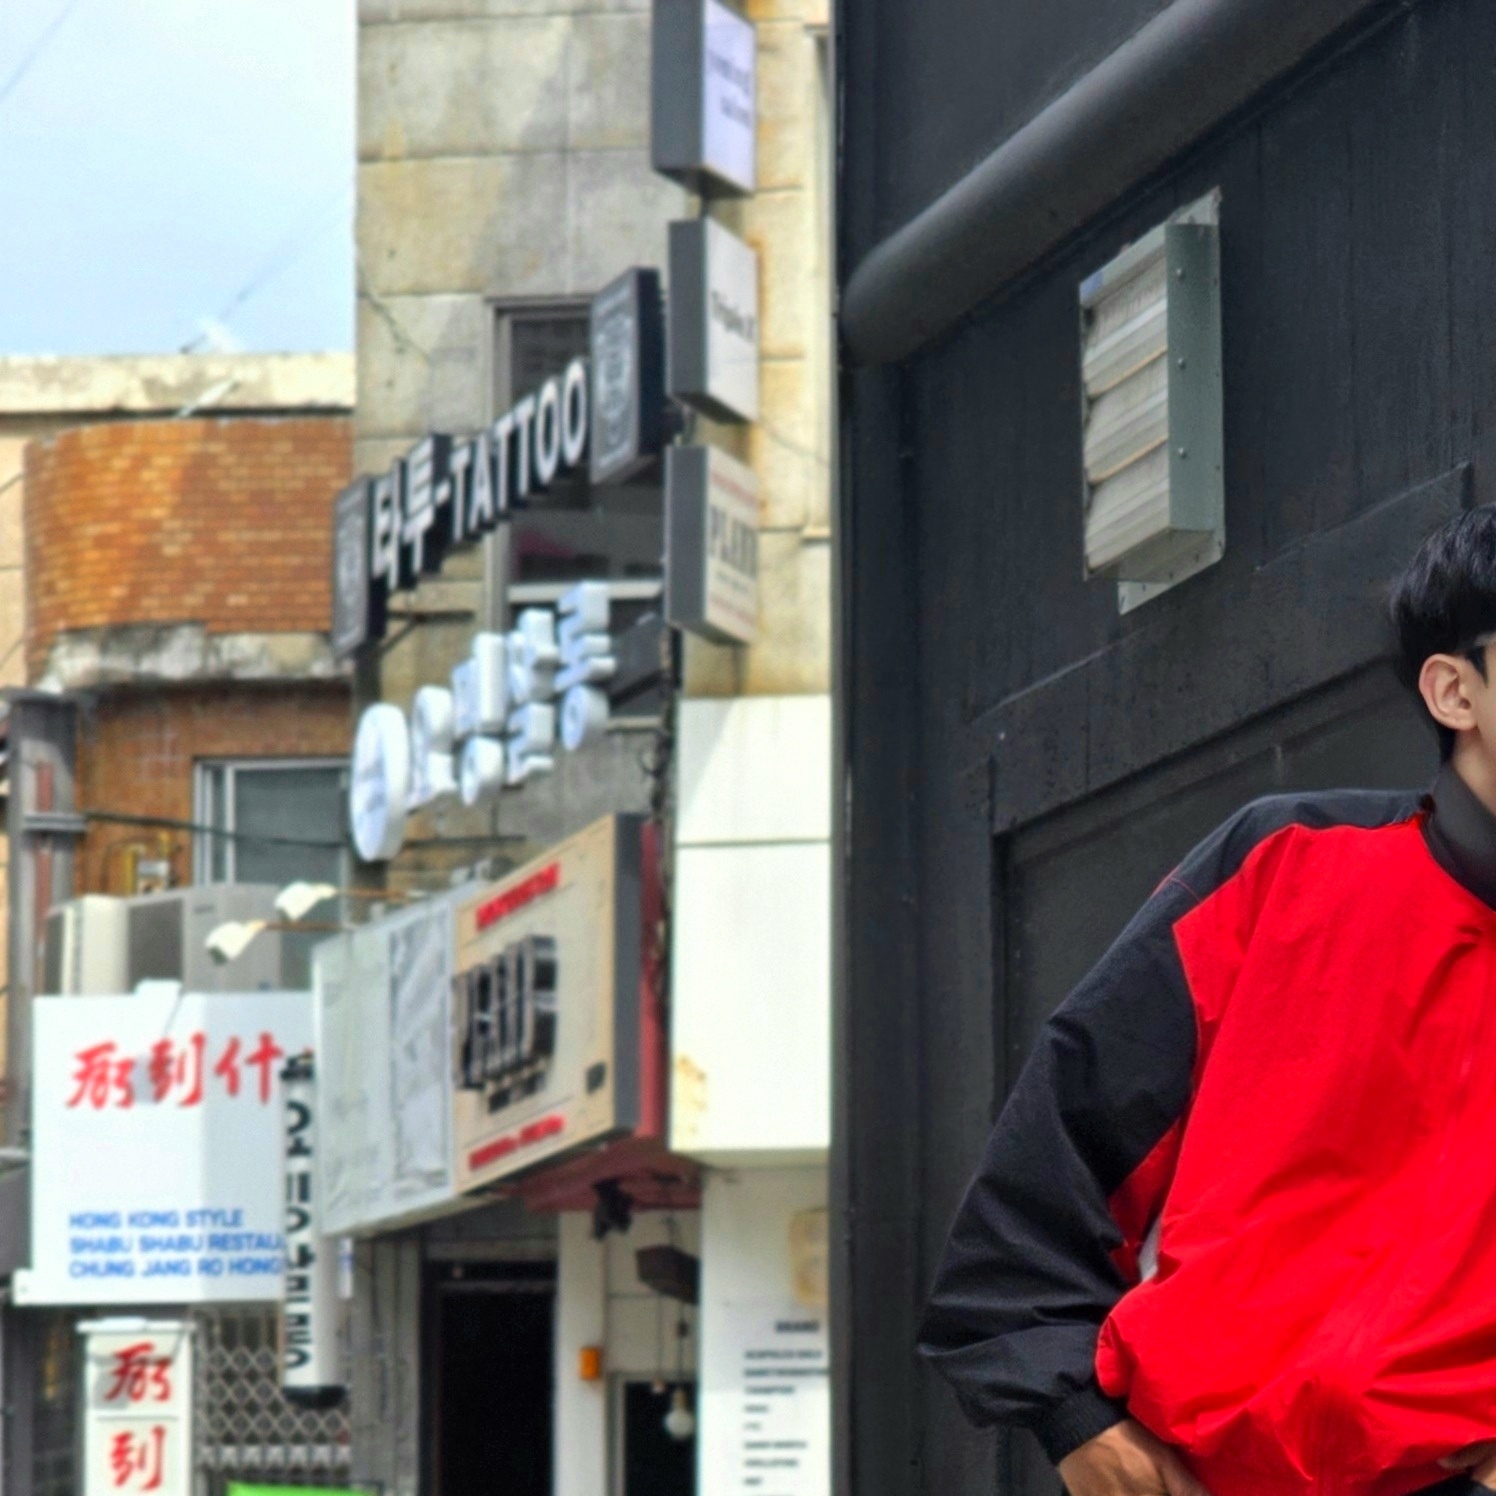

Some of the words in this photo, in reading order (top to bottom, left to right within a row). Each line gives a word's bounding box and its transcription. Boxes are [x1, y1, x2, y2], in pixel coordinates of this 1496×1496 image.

[69, 1211, 121, 1228] HONG
[128, 1210, 179, 1228] KONG
[186, 1208, 243, 1227] STYLE
[69, 1260, 134, 1278] CHUNG
[142, 1259, 190, 1277] JANG
